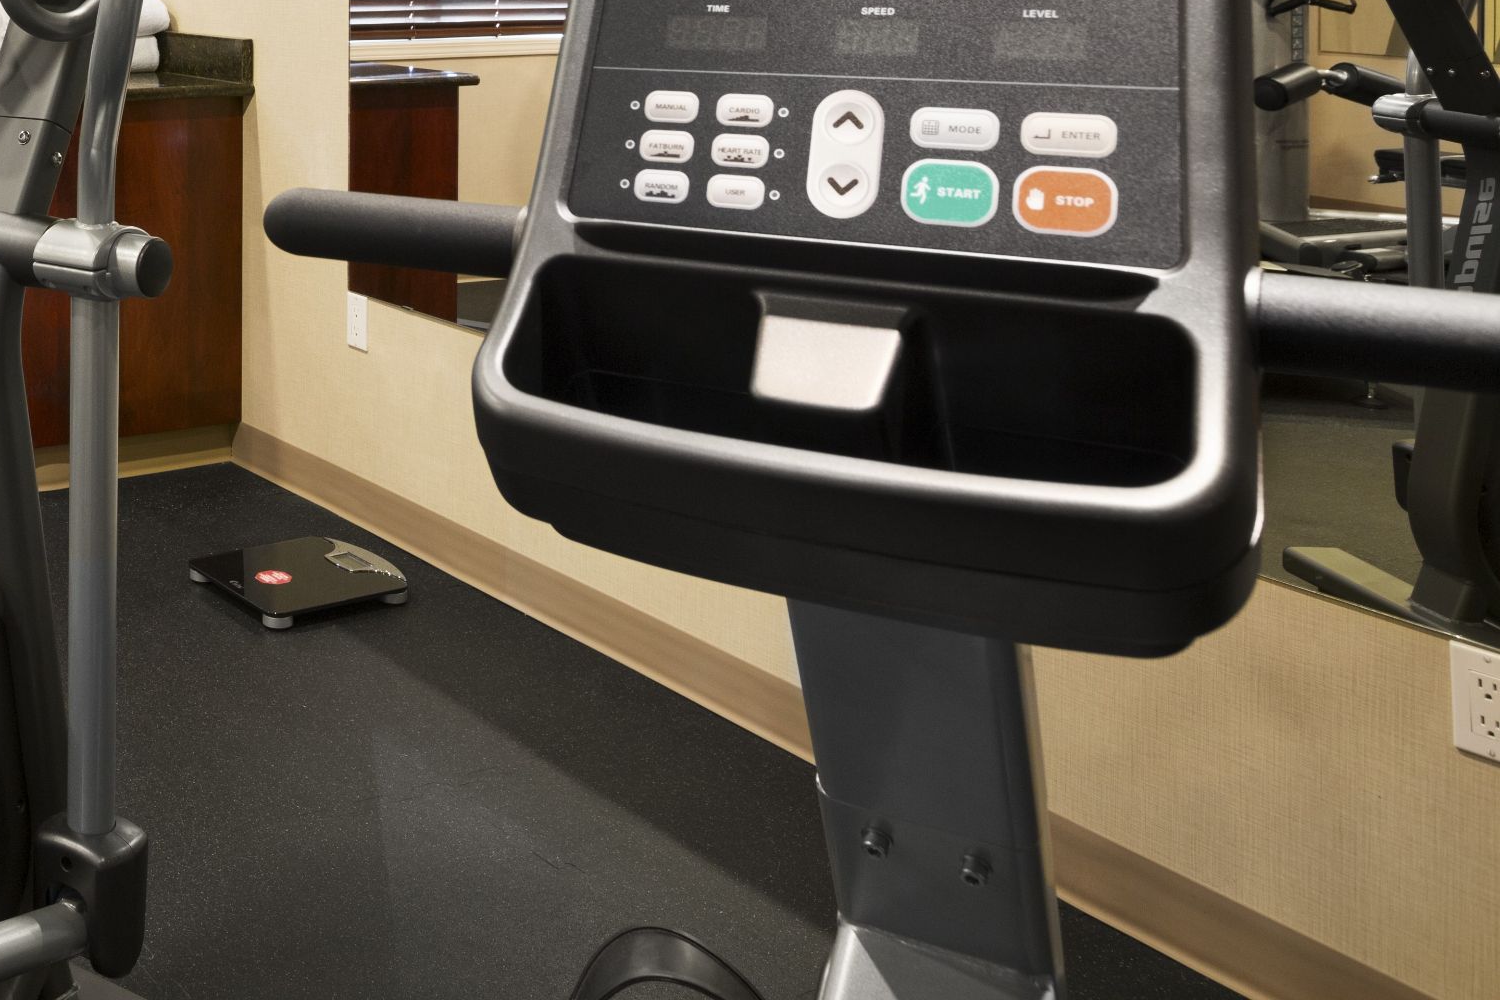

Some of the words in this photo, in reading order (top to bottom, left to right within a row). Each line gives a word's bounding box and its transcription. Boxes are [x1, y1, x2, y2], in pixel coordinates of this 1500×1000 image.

[707, 5, 730, 13] TIME
[861, 7, 895, 15] SPEED
[1023, 10, 1059, 18] LEVEL
[948, 125, 982, 134] MODE
[1061, 131, 1100, 140] ENTER
[718, 147, 742, 155] HEART
[937, 188, 981, 199] START
[1055, 196, 1095, 207] STOP
